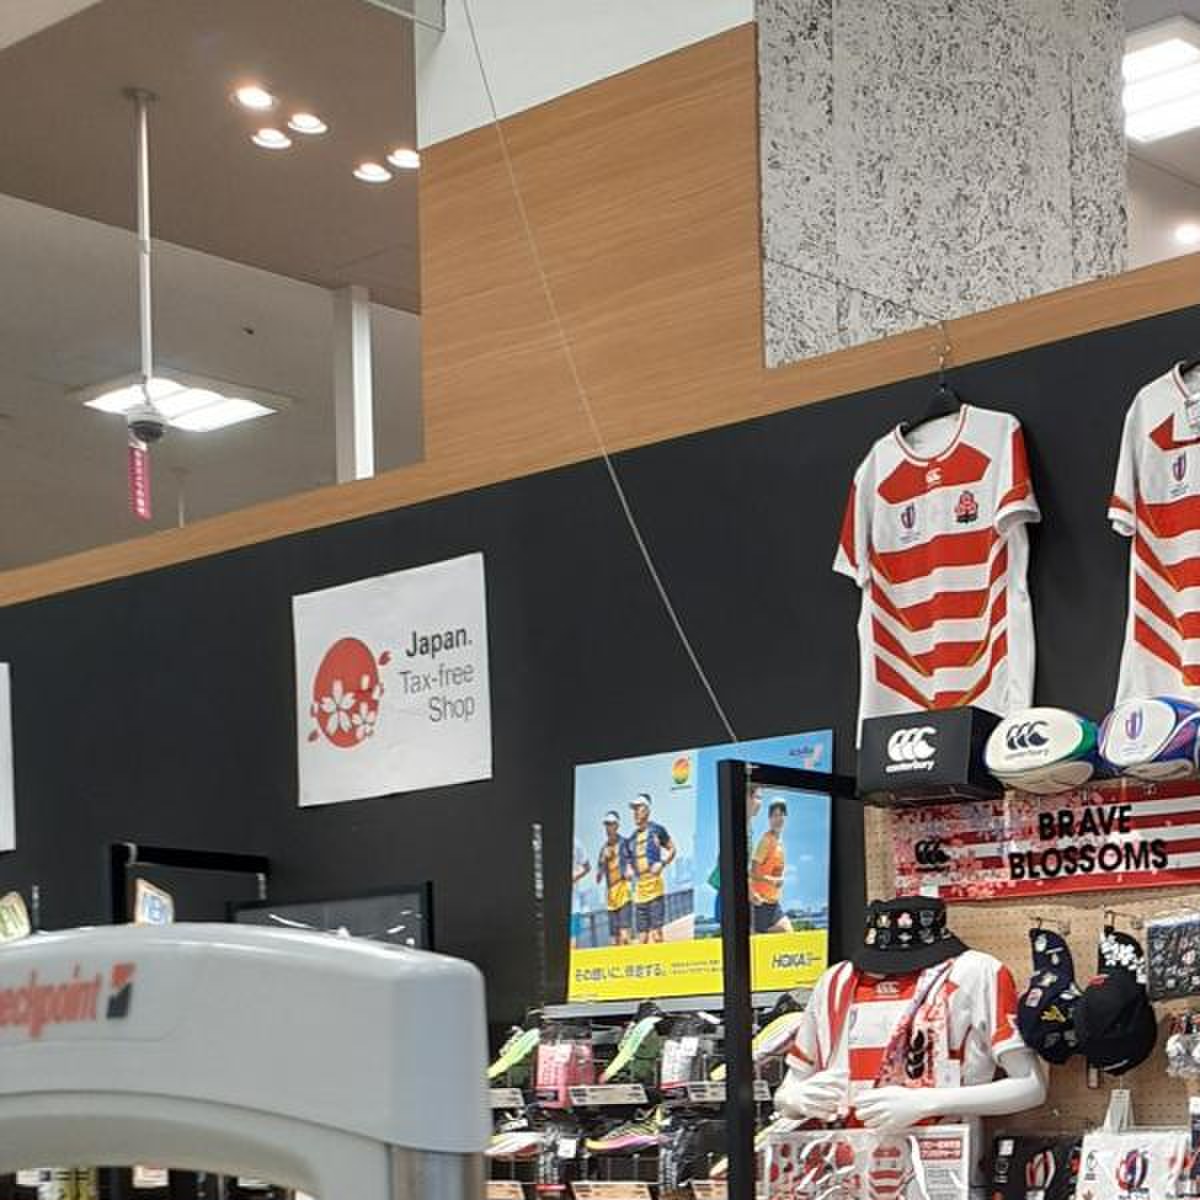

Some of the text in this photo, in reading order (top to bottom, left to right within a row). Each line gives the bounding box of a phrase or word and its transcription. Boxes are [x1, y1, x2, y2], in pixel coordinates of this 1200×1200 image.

[405, 628, 473, 659] Japan.
[398, 663, 475, 694] Tax-free
[429, 695, 475, 722] Shop
[1038, 804, 1133, 840] BRAVE
[1009, 839, 1168, 880] BLOSSOMS
